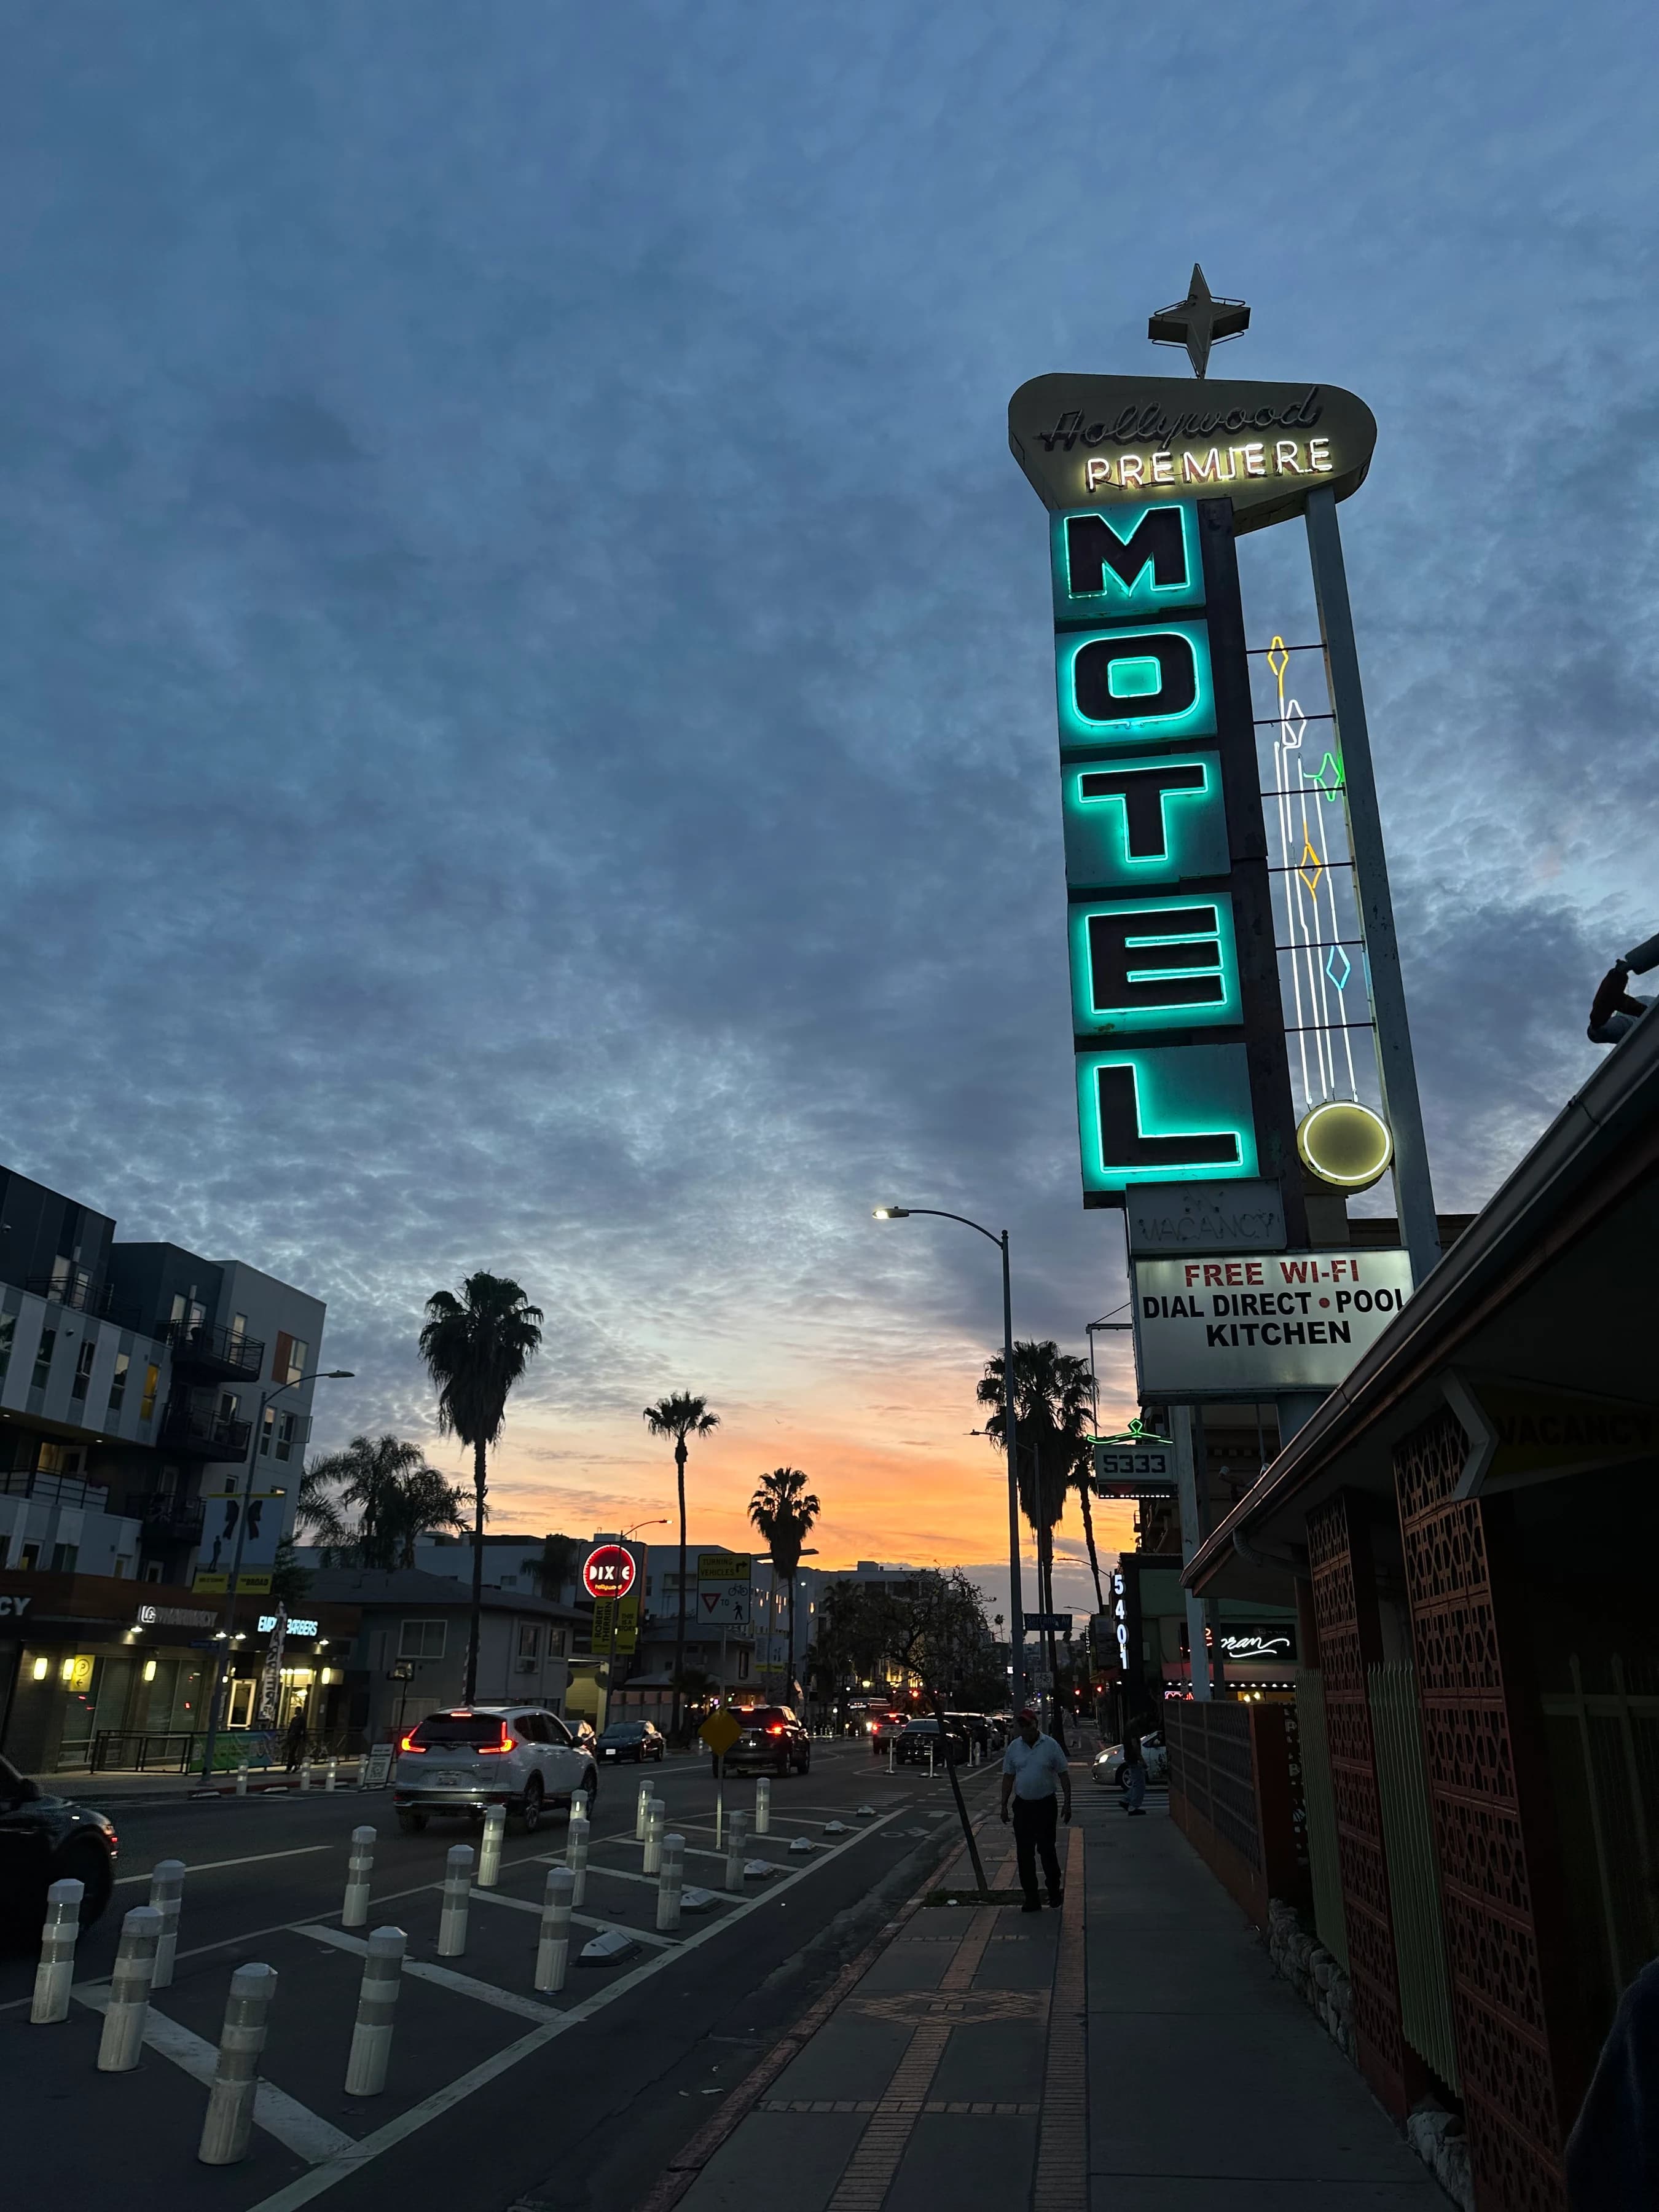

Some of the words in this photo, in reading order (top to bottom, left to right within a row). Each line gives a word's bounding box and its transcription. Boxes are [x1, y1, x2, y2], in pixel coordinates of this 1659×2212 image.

[1033, 386, 1322, 451] Hollywood
[1085, 437, 1333, 492] PREMIERE
[1064, 504, 1244, 1174] MOTEL
[1185, 1262, 1264, 1287] FREE
[1279, 1259, 1359, 1284] WI-FI
[1142, 1294, 1204, 1319] DIAL
[1212, 1292, 1312, 1317] DIRECT
[1206, 1320, 1352, 1347] KITCHEN
[1493, 1414, 1650, 1445] VACANCY
[1103, 1454, 1166, 1473] 5333
[589, 1566, 630, 1580] DIXE
[594, 1606, 603, 1638] ROBERT
[602, 1601, 612, 1642] THERRIEN
[1114, 1574, 1129, 1669] 5401
